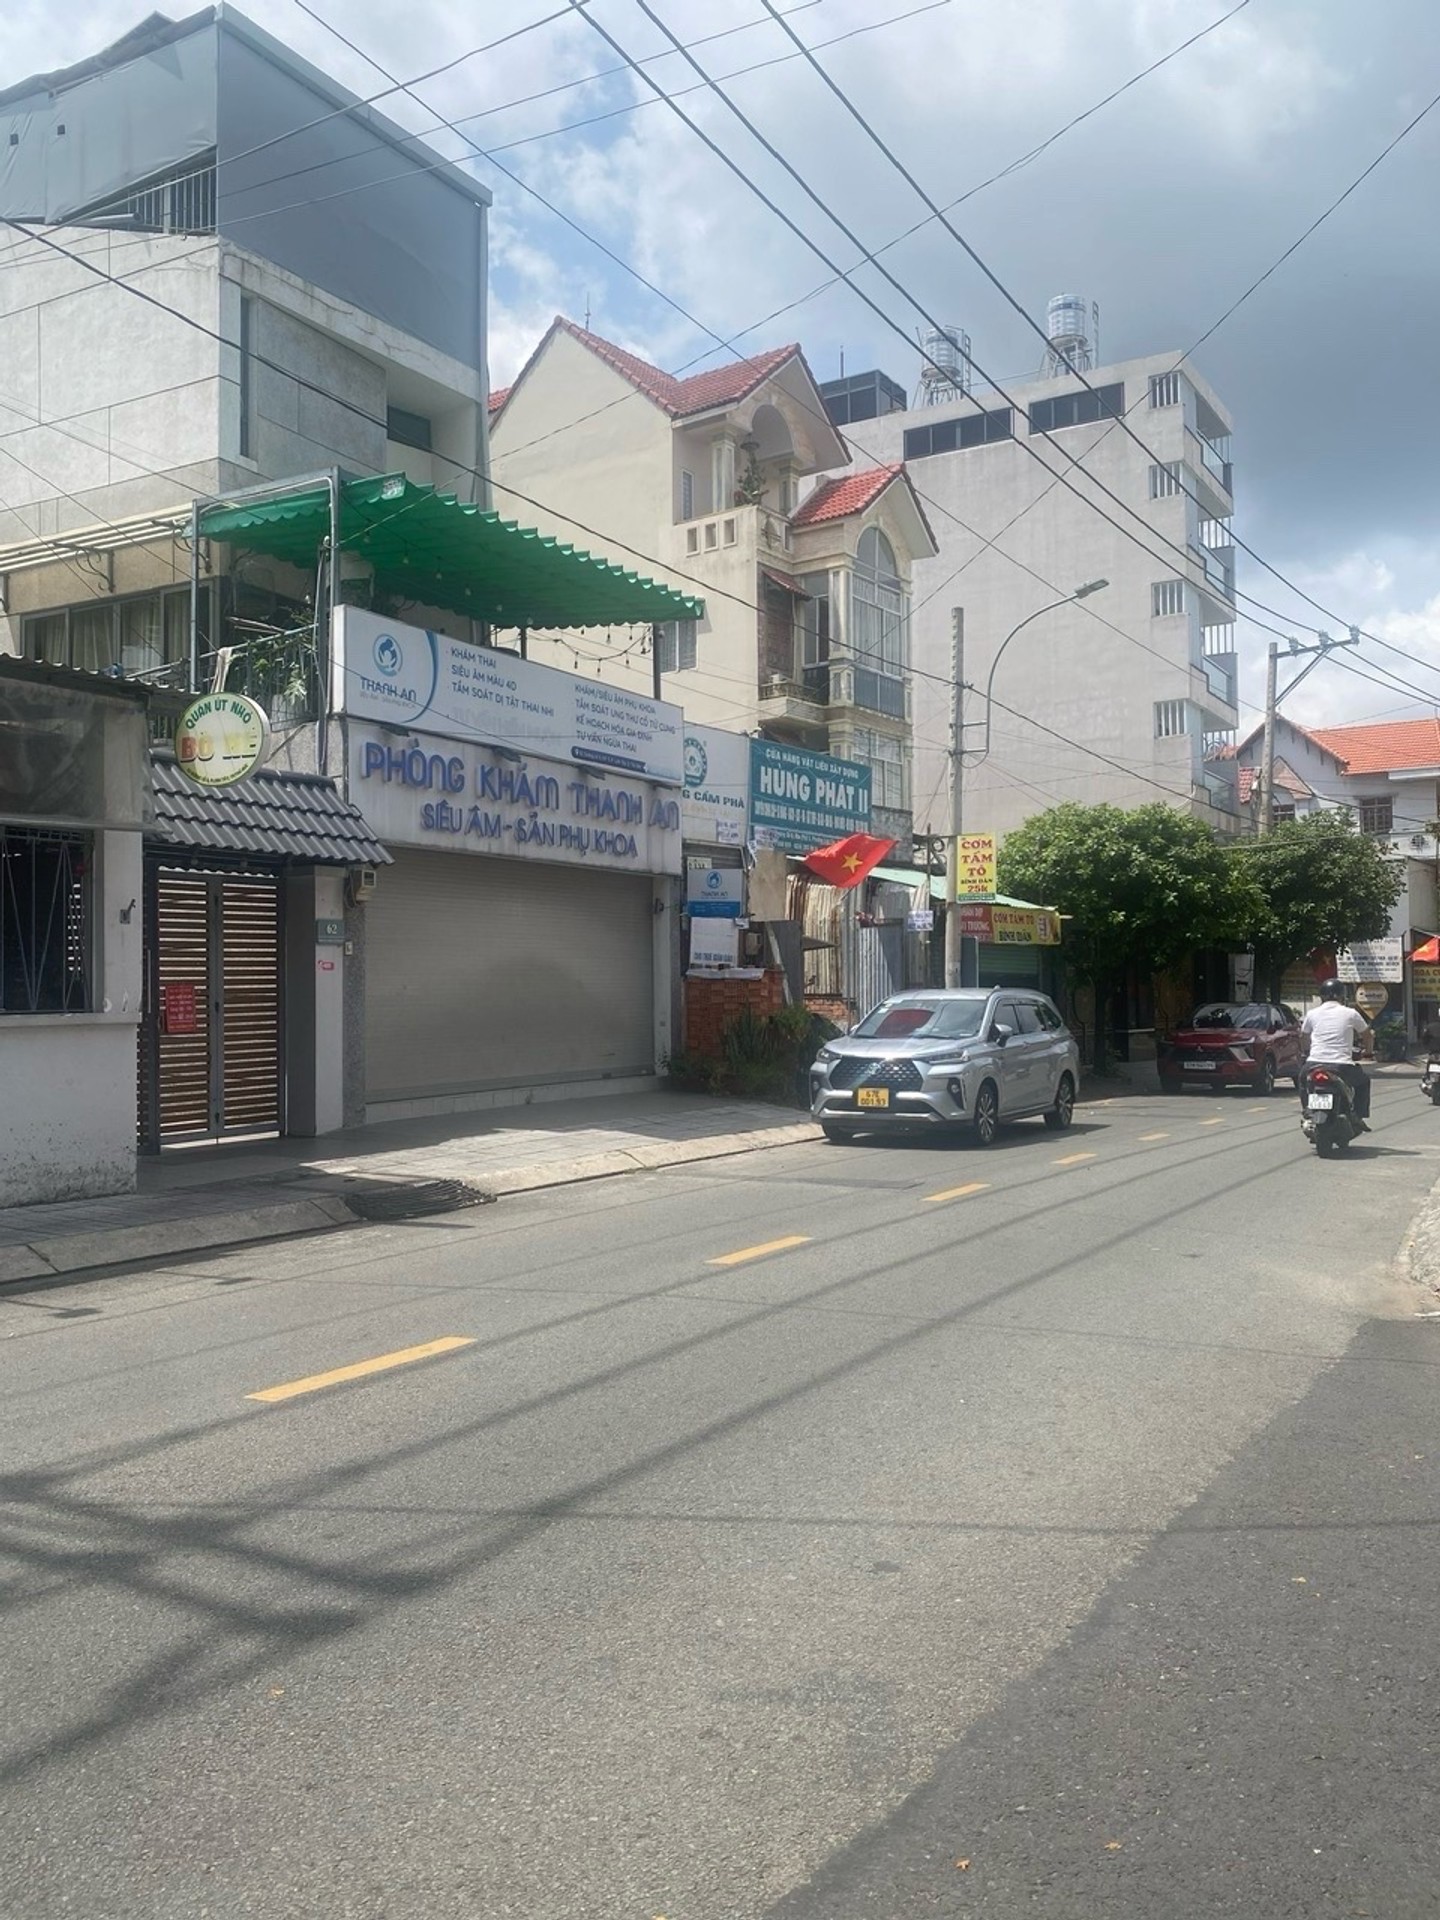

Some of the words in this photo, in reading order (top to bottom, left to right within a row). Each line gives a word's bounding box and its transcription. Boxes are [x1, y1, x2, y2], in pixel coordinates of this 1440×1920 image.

[451, 647, 475, 661] KHÁM
[478, 655, 496, 669] THAI
[451, 663, 470, 678] SIÊU
[361, 738, 465, 793] PHÒNG
[477, 762, 560, 812] KHÁM
[568, 781, 643, 825] THANH
[649, 798, 680, 831] AN
[760, 763, 811, 801] HÙNG
[815, 778, 854, 810] PHÁT
[421, 799, 463, 833] SIÊU
[464, 805, 502, 839] ÂM
[559, 824, 590, 857] PHỤ
[593, 829, 638, 858] KHOA
[961, 839, 992, 850] CƠM
[961, 851, 993, 864] TẤM
[326, 923, 338, 935] 62
